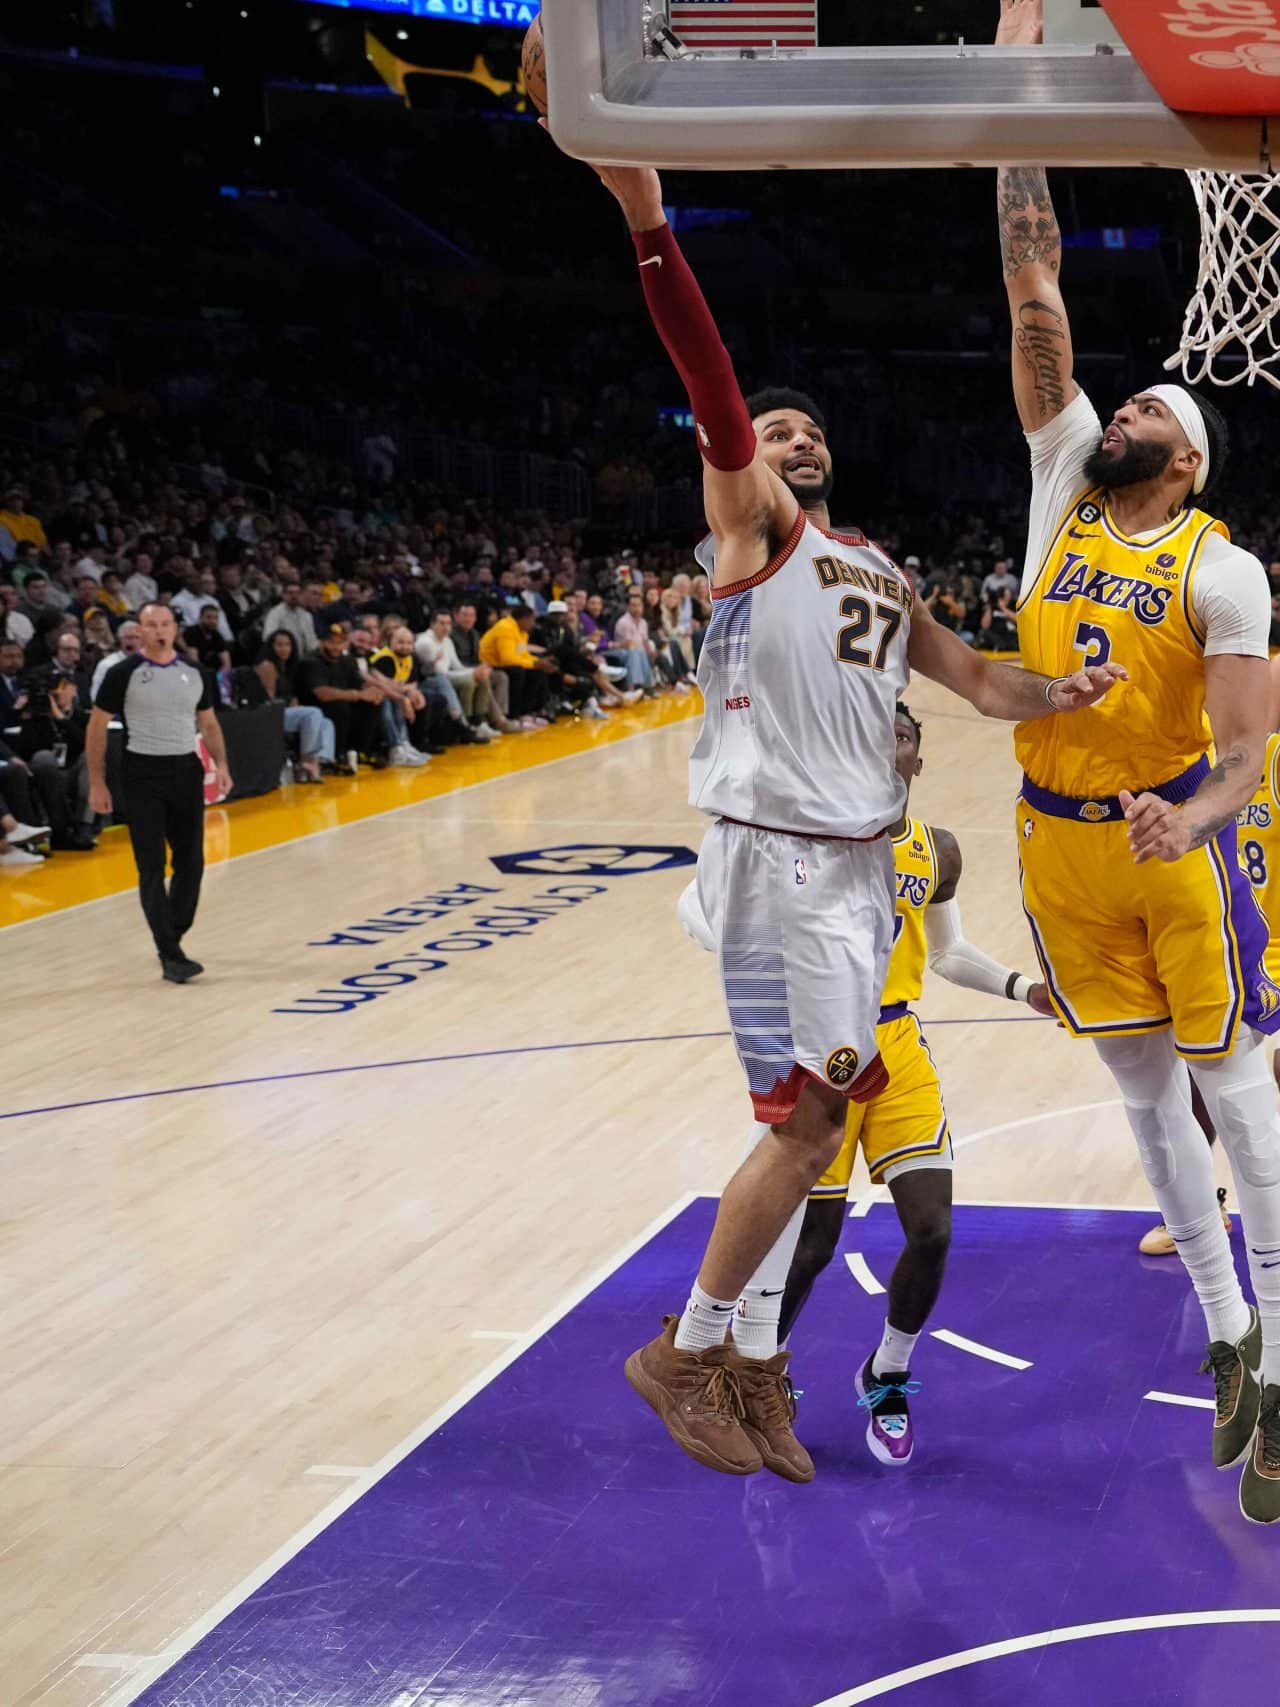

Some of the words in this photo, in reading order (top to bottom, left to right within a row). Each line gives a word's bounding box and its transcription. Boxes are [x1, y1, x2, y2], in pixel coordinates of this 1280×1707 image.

[452, 0, 533, 22] DELTA
[811, 554, 915, 617] DENVER
[1043, 551, 1174, 626] LAKERS
[1145, 563, 1179, 581] bibigo
[836, 594, 903, 673] 27
[1237, 802, 1273, 829] ERS
[1242, 840, 1268, 886] 8
[306, 882, 505, 948] ARENA
[270, 883, 609, 1014] crypto.com
